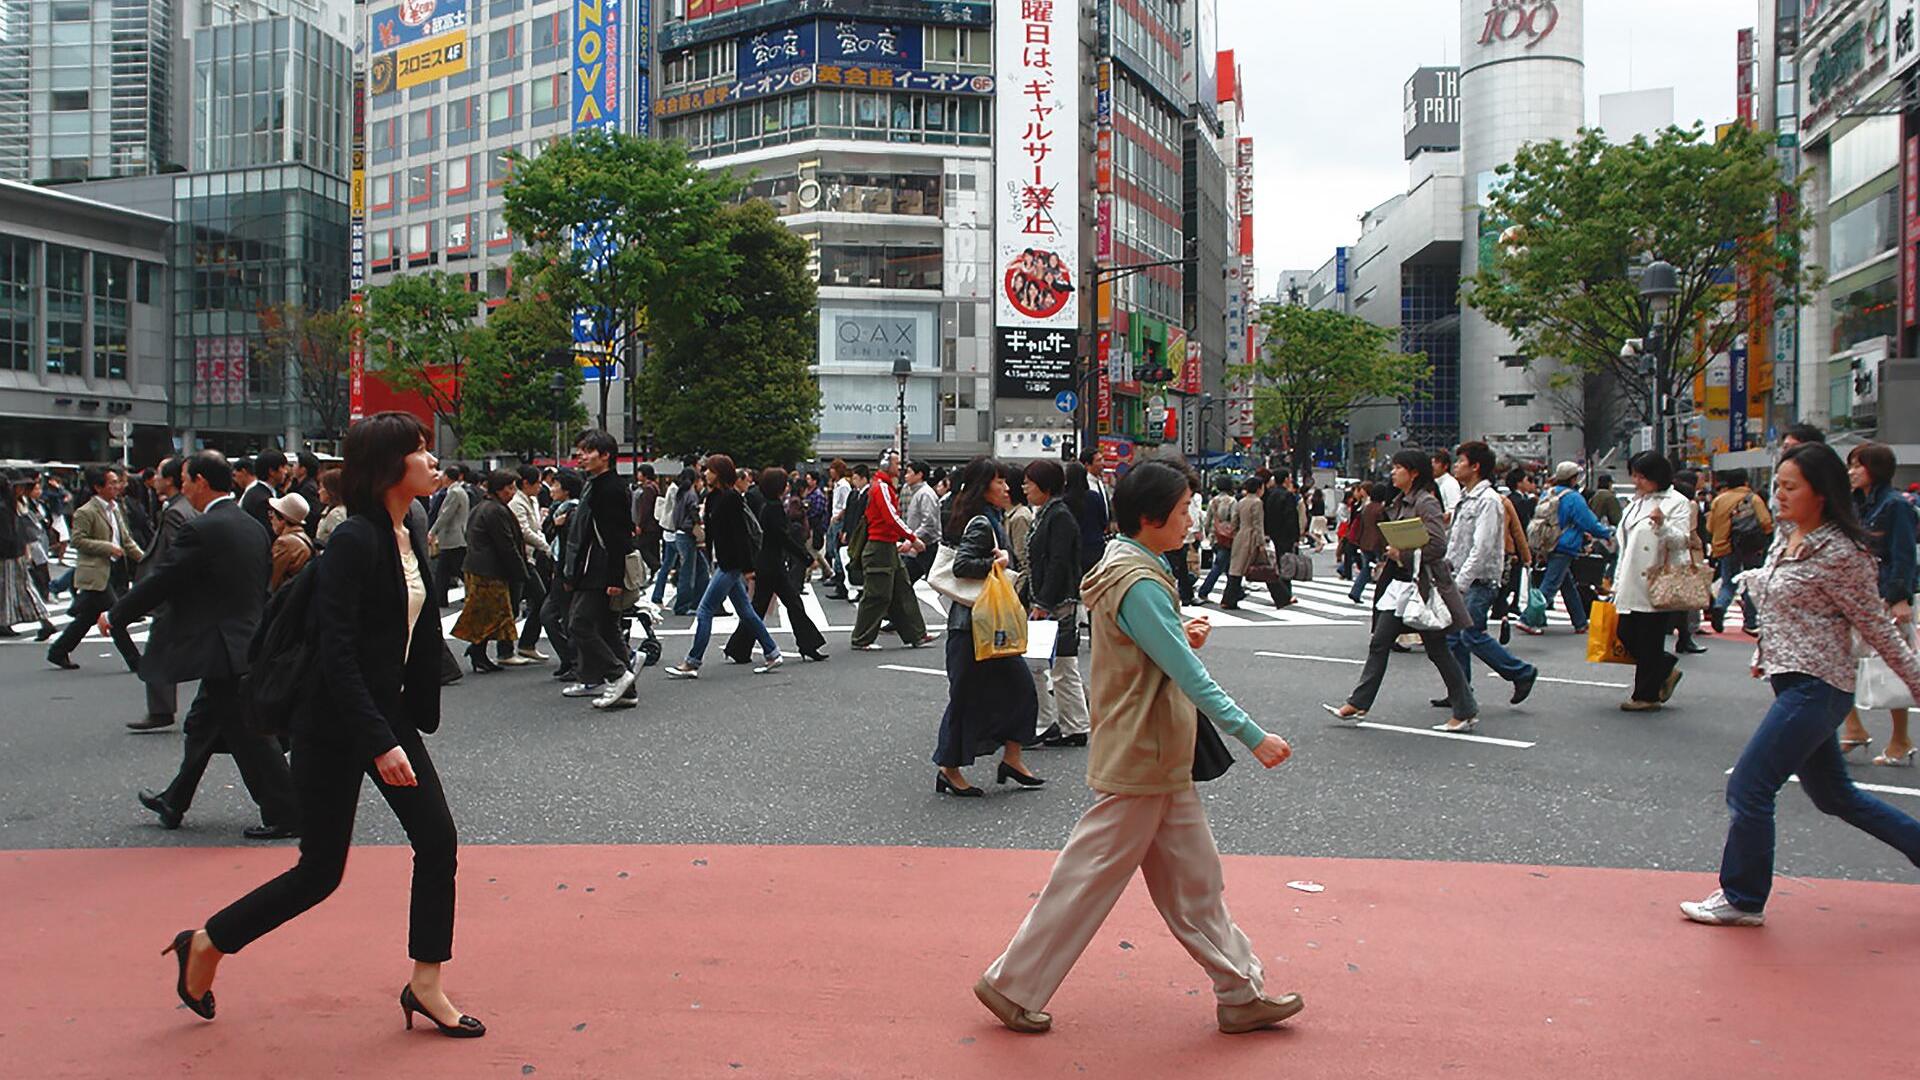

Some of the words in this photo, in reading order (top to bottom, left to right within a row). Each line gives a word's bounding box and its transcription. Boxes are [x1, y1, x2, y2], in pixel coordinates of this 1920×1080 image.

[1477, 2, 1559, 49] 109
[399, 49, 442, 77] プロミス
[576, 0, 602, 123] NOVA
[730, 74, 788, 99] イーオン
[817, 65, 893, 87] 英会話
[896, 71, 968, 91] イーオン
[972, 78, 993, 90] 6F
[1436, 71, 1457, 97] TH
[1005, 330, 1071, 353] ギャルサー
